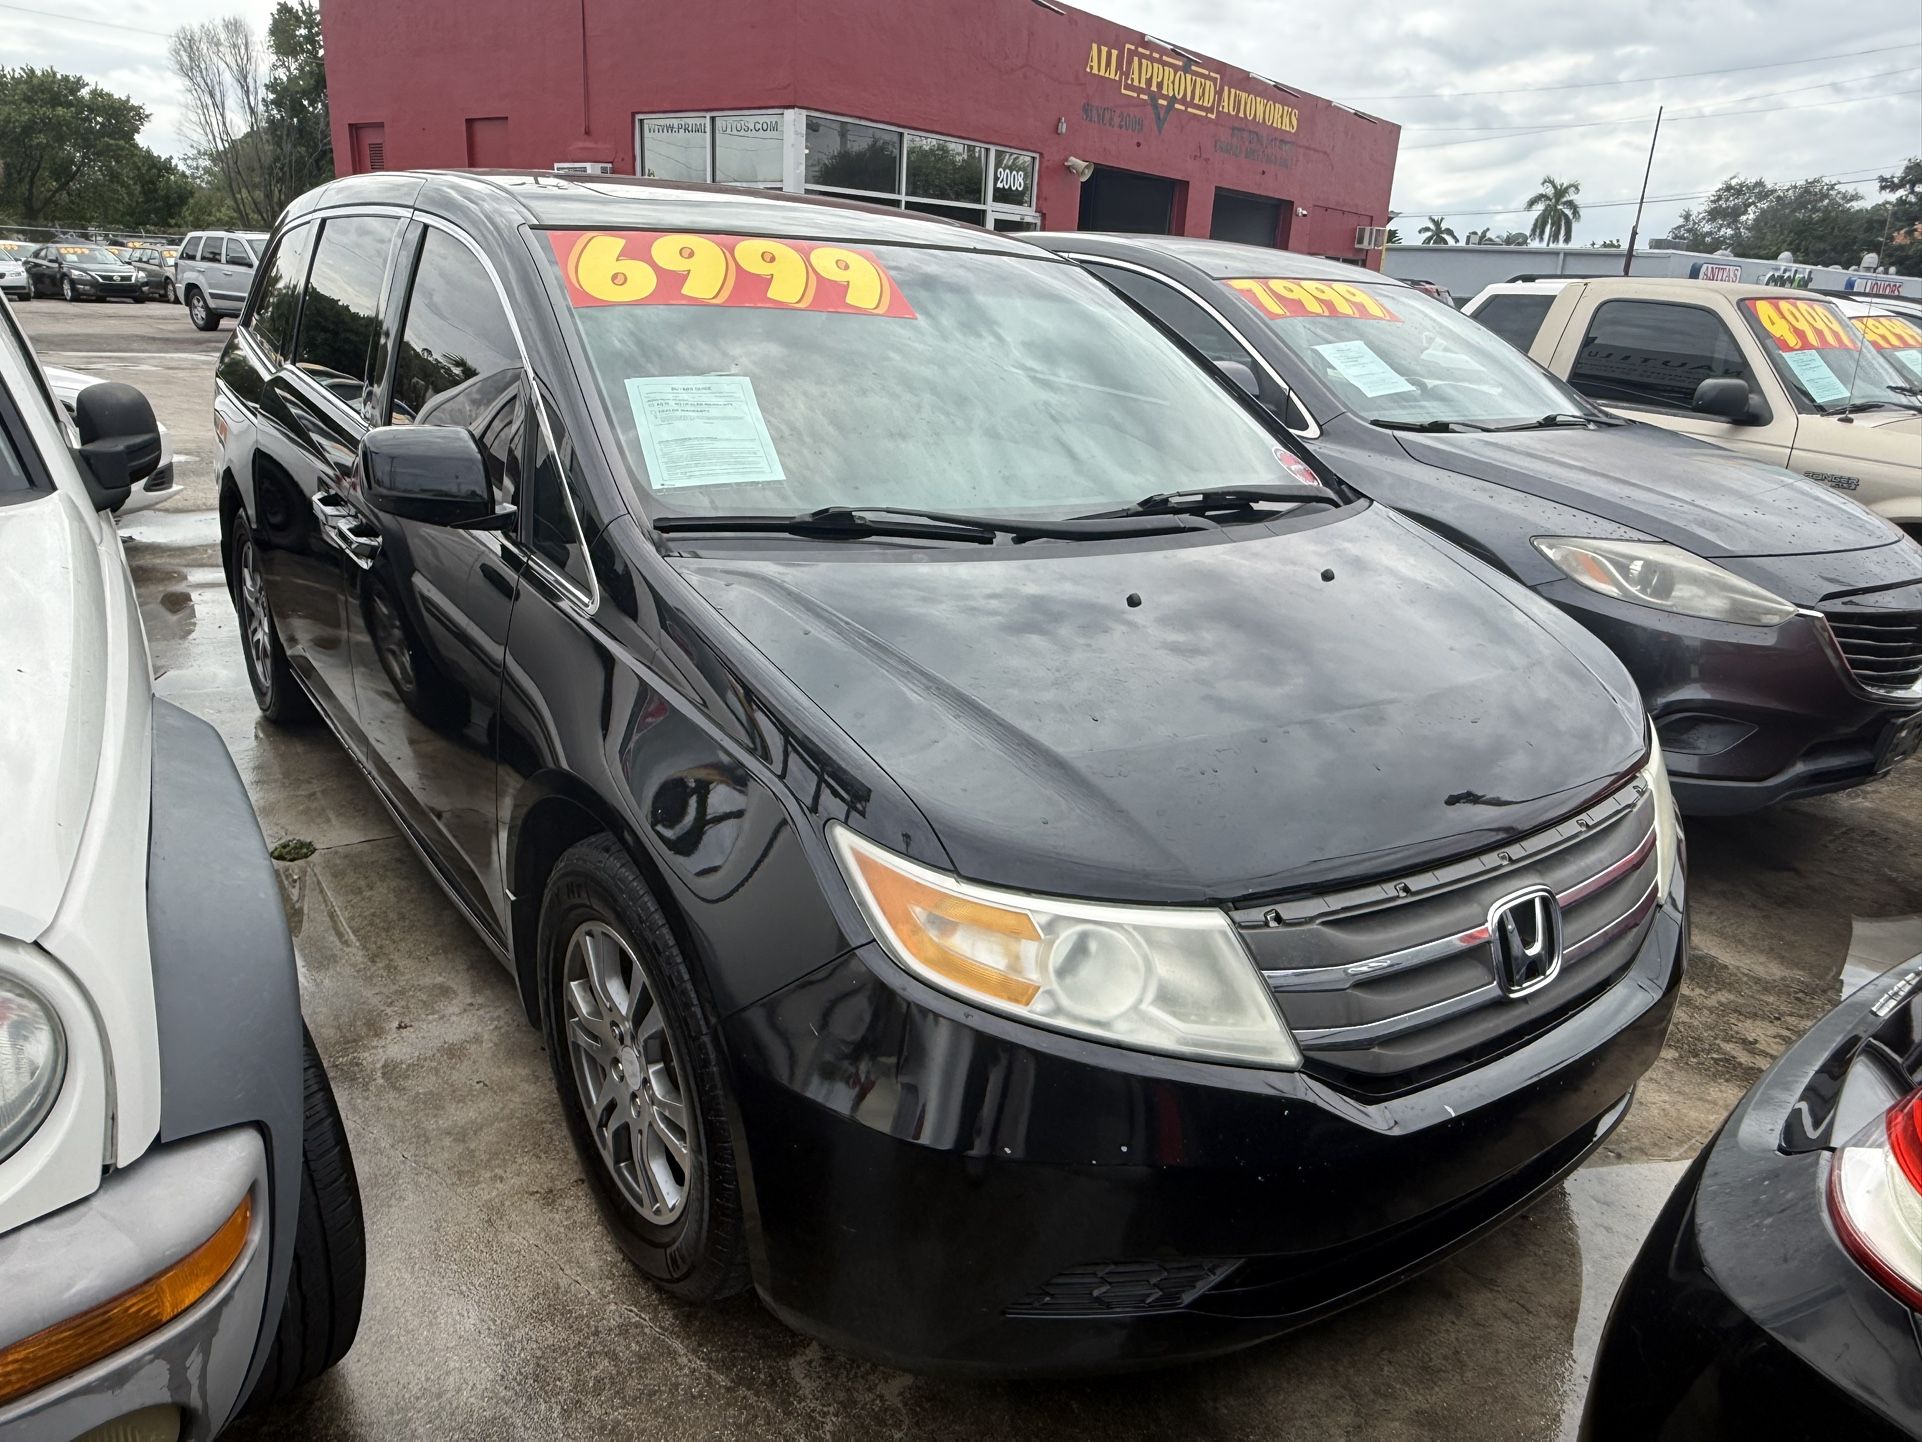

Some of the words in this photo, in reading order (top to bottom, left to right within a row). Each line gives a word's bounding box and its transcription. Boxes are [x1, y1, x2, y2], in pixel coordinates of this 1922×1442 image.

[1086, 43, 1119, 80] ALL
[1127, 56, 1215, 108] APPROVED
[1219, 86, 1299, 133] AUTOWORKS
[647, 120, 779, 134] WWW.PRIMEUTOS.COM
[996, 167, 1024, 191] 2008
[567, 232, 890, 314] 6999
[1227, 278, 1391, 320] 7999
[1755, 299, 1859, 349] 4999
